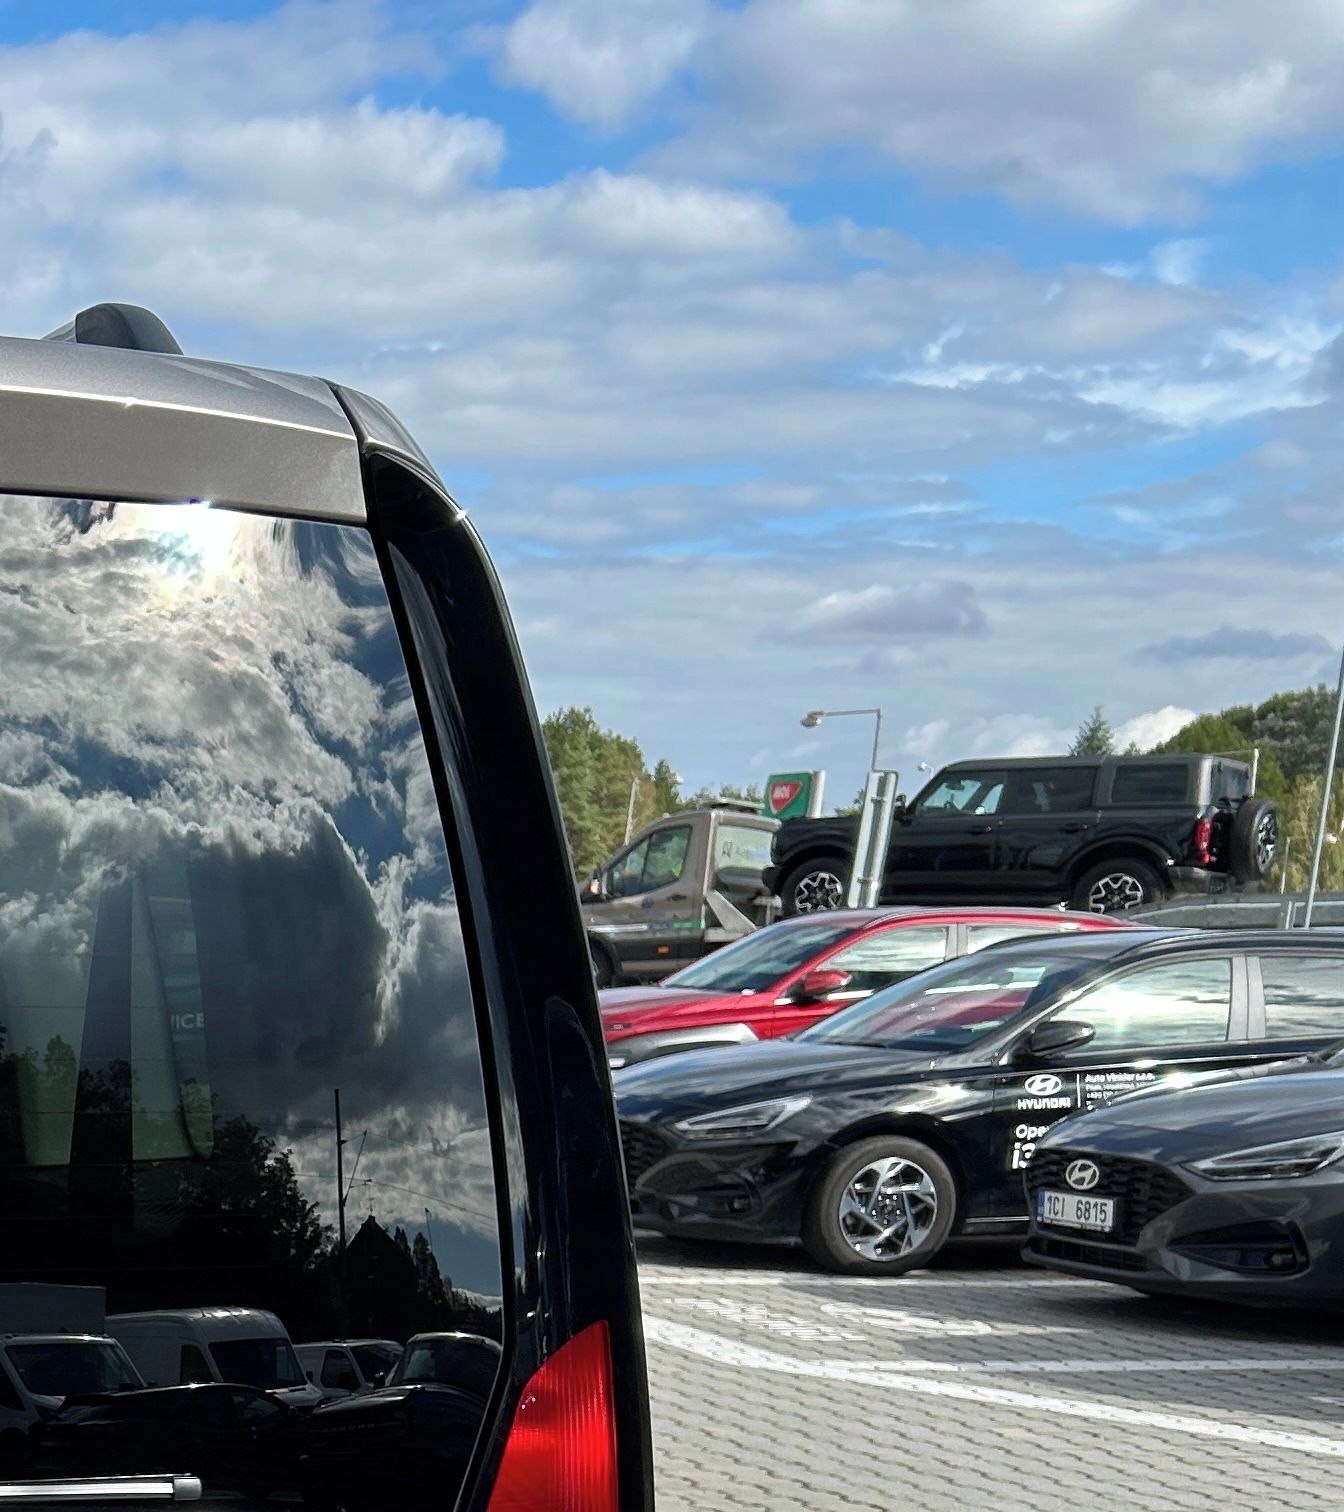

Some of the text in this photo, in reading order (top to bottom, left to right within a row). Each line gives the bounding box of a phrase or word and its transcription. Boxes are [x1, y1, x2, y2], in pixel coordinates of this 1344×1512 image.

[1018, 1098, 1071, 1110] HYUNDAI
[1047, 1195, 1108, 1224] 1CI 6815
